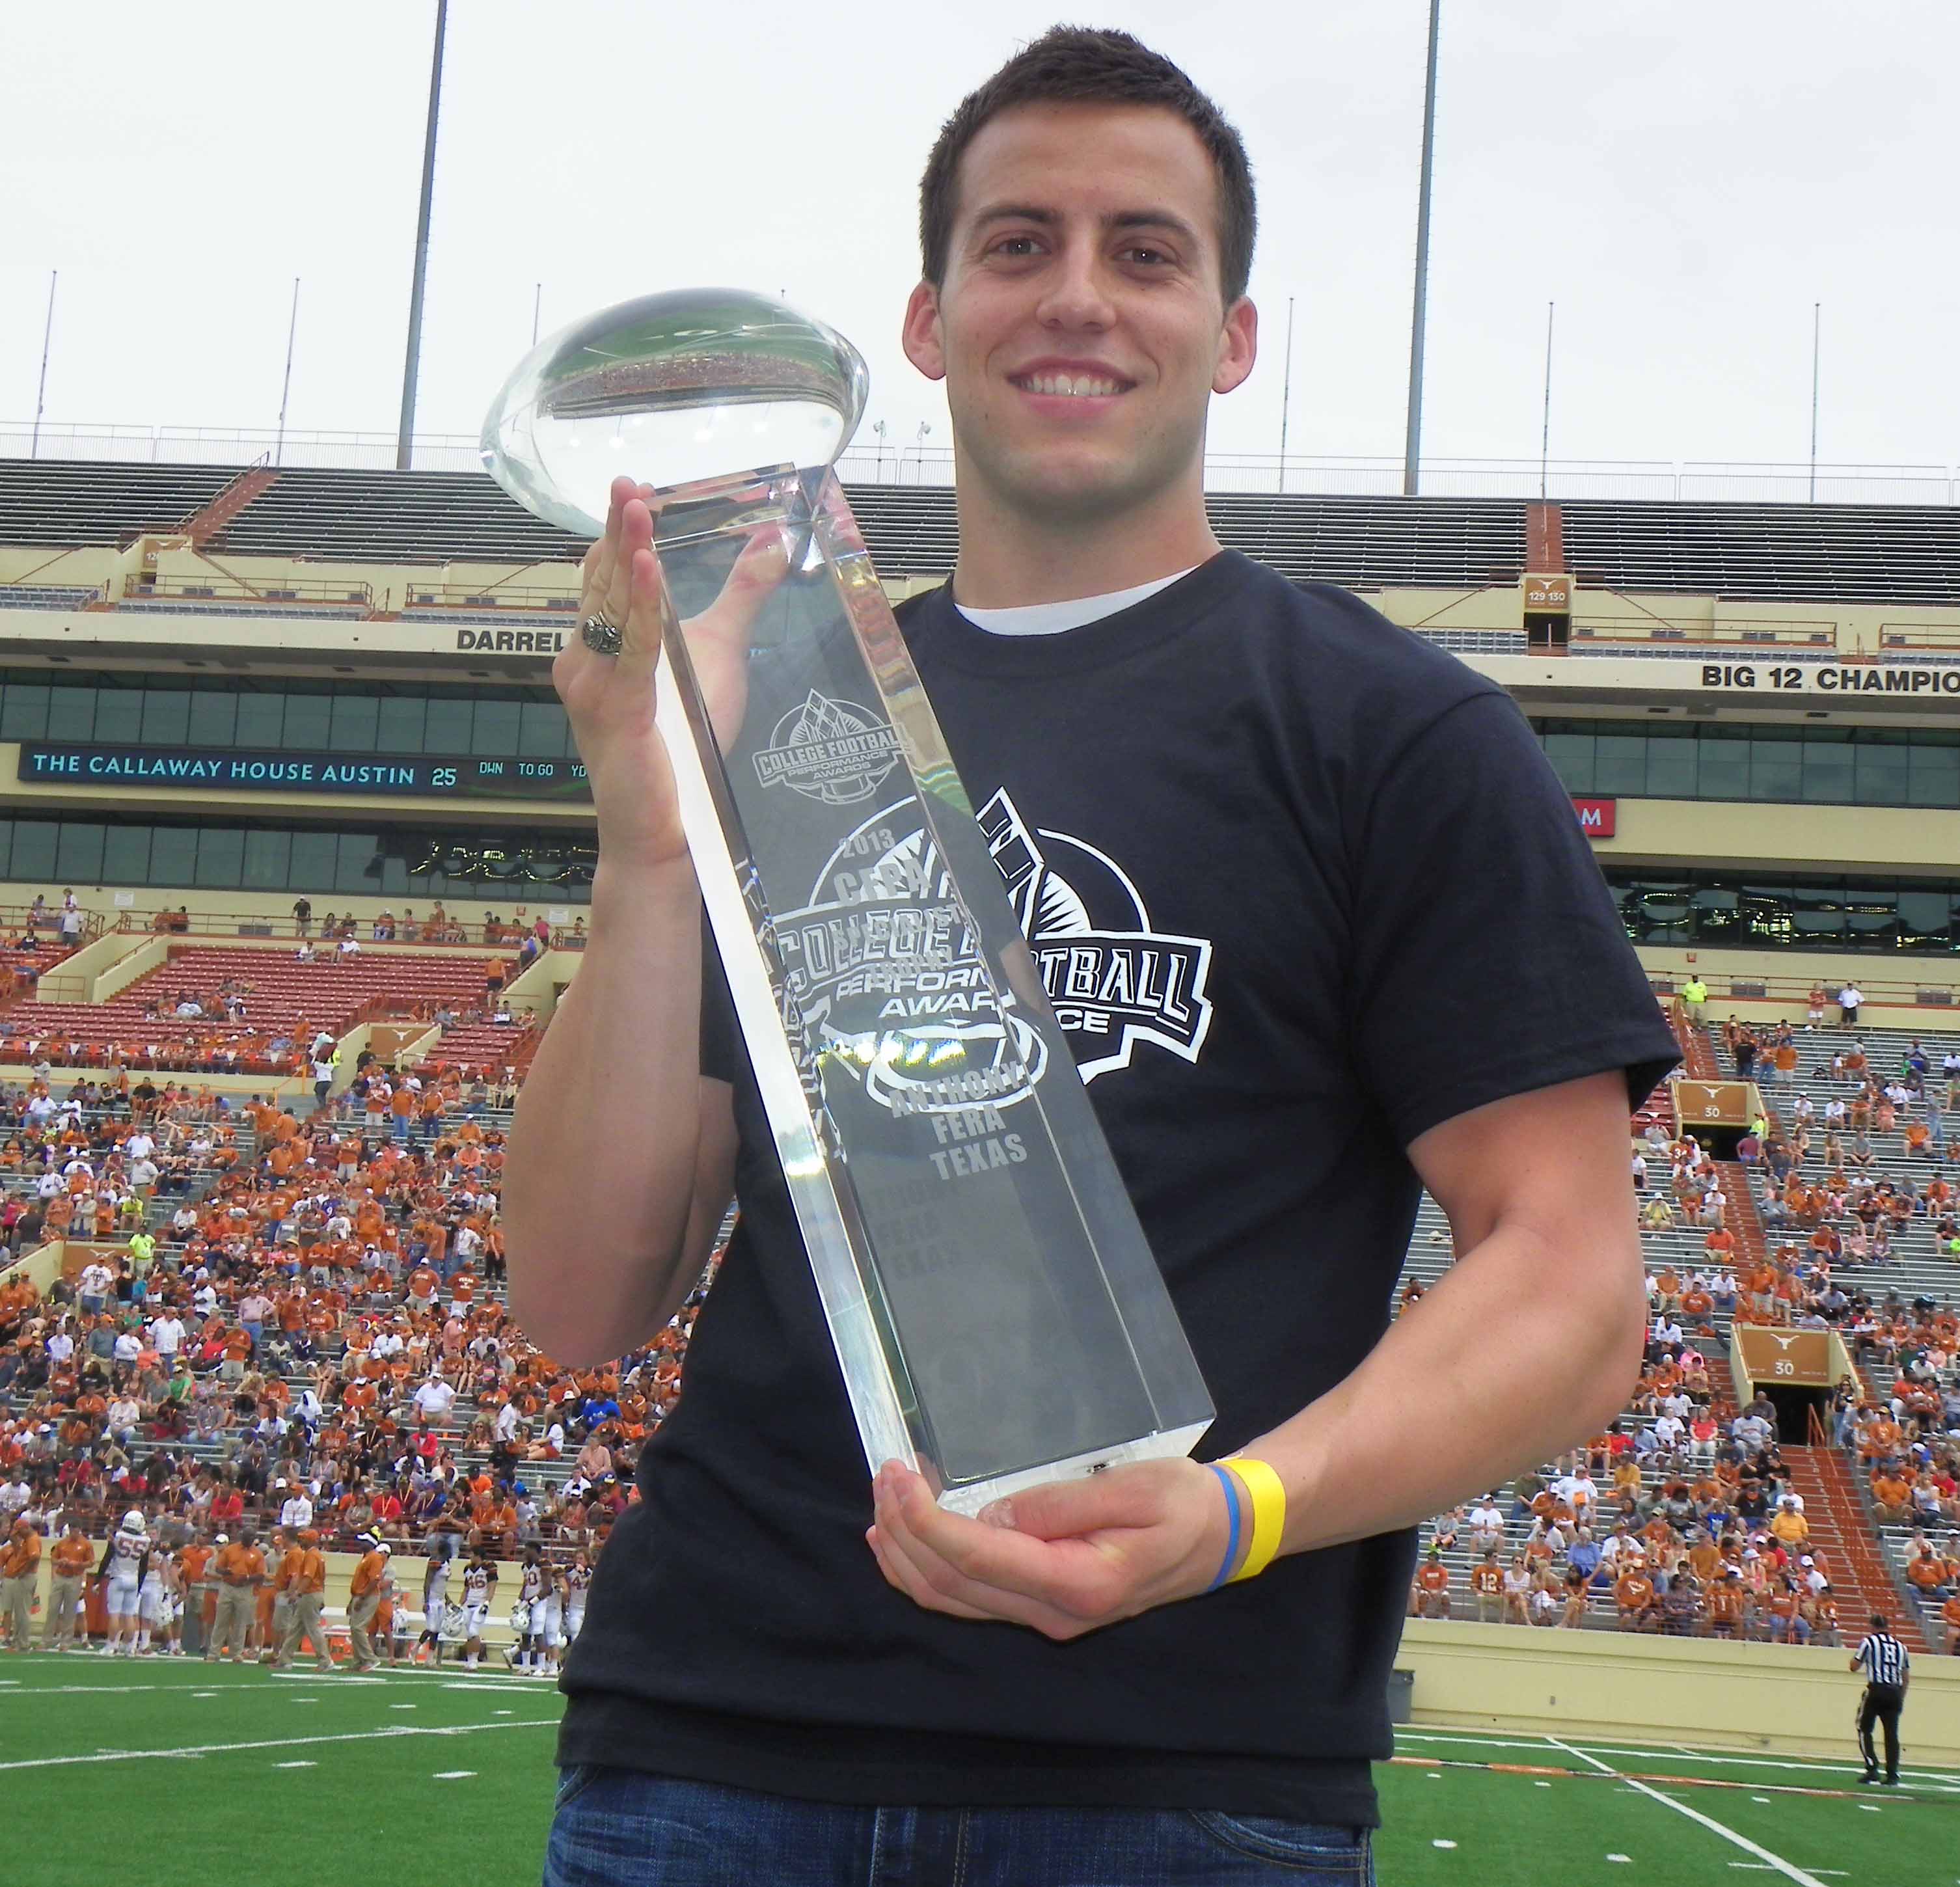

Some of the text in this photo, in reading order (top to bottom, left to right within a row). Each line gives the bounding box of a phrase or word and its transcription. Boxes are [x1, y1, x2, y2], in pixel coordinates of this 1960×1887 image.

[1529, 591, 1566, 601] 129 130
[457, 630, 563, 652] DARREL
[1702, 666, 1960, 692] BIG 12 CHAMPIO
[33, 753, 415, 784] THE CALLAWAY HOUSE AUSTIN
[479, 761, 503, 774] DWN
[519, 763, 534, 775] TO
[538, 764, 554, 776] GO
[759, 744, 825, 776] COLLEGE
[787, 750, 889, 777] PERFORMANCE
[813, 763, 872, 780] AWARDS
[431, 767, 457, 787] 25
[1582, 808, 1601, 826] M
[839, 828, 896, 859] 2013
[833, 856, 932, 906] CFPA
[888, 1060, 1024, 1119] ANTHONY
[931, 1103, 1006, 1145] FERA
[1704, 1107, 1720, 1118] 30
[929, 1134, 1028, 1180] TEXAS
[1775, 1362, 1794, 1376] 30
[118, 1535, 147, 1560] 55
[1480, 1572, 1497, 1592] 12
